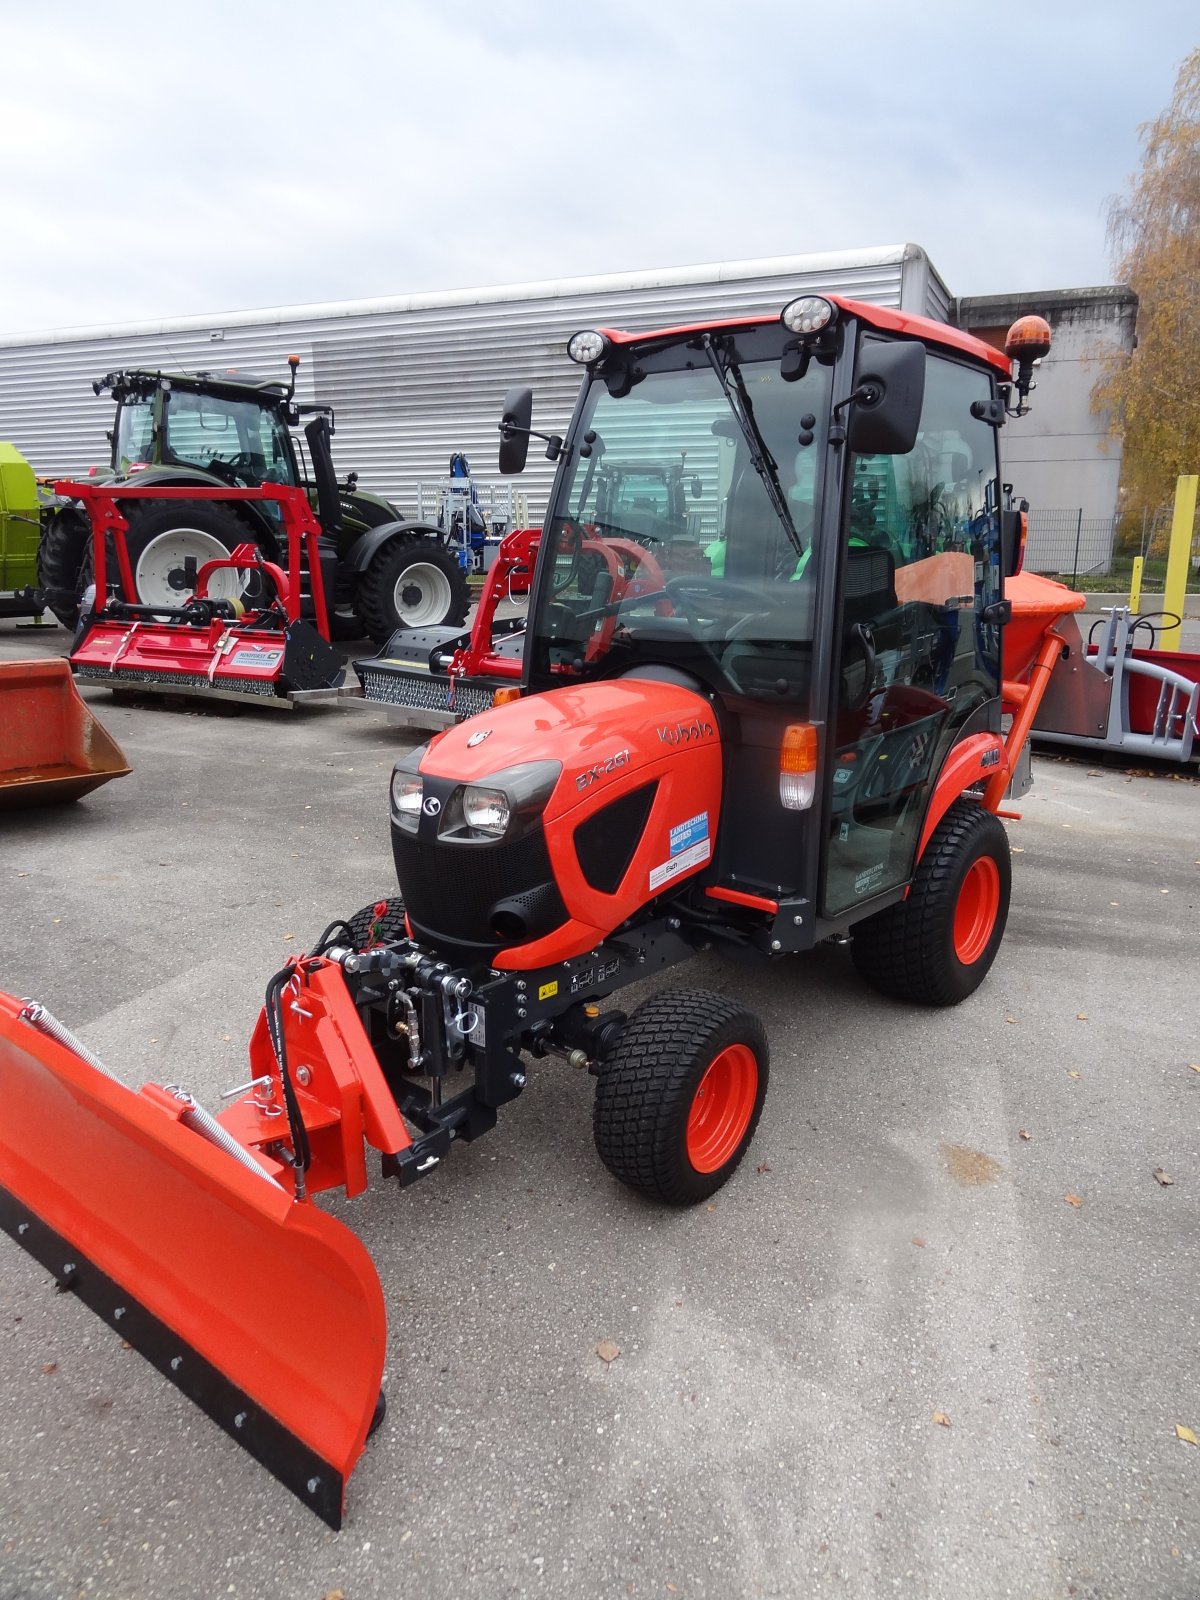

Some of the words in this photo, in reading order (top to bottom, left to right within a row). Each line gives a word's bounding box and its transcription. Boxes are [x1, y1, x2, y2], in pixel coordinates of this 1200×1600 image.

[656, 719, 714, 746] Kubota
[575, 749, 631, 792] BX-261
[671, 811, 708, 836] LANDTECHNIK
[665, 861, 678, 874] Esch
